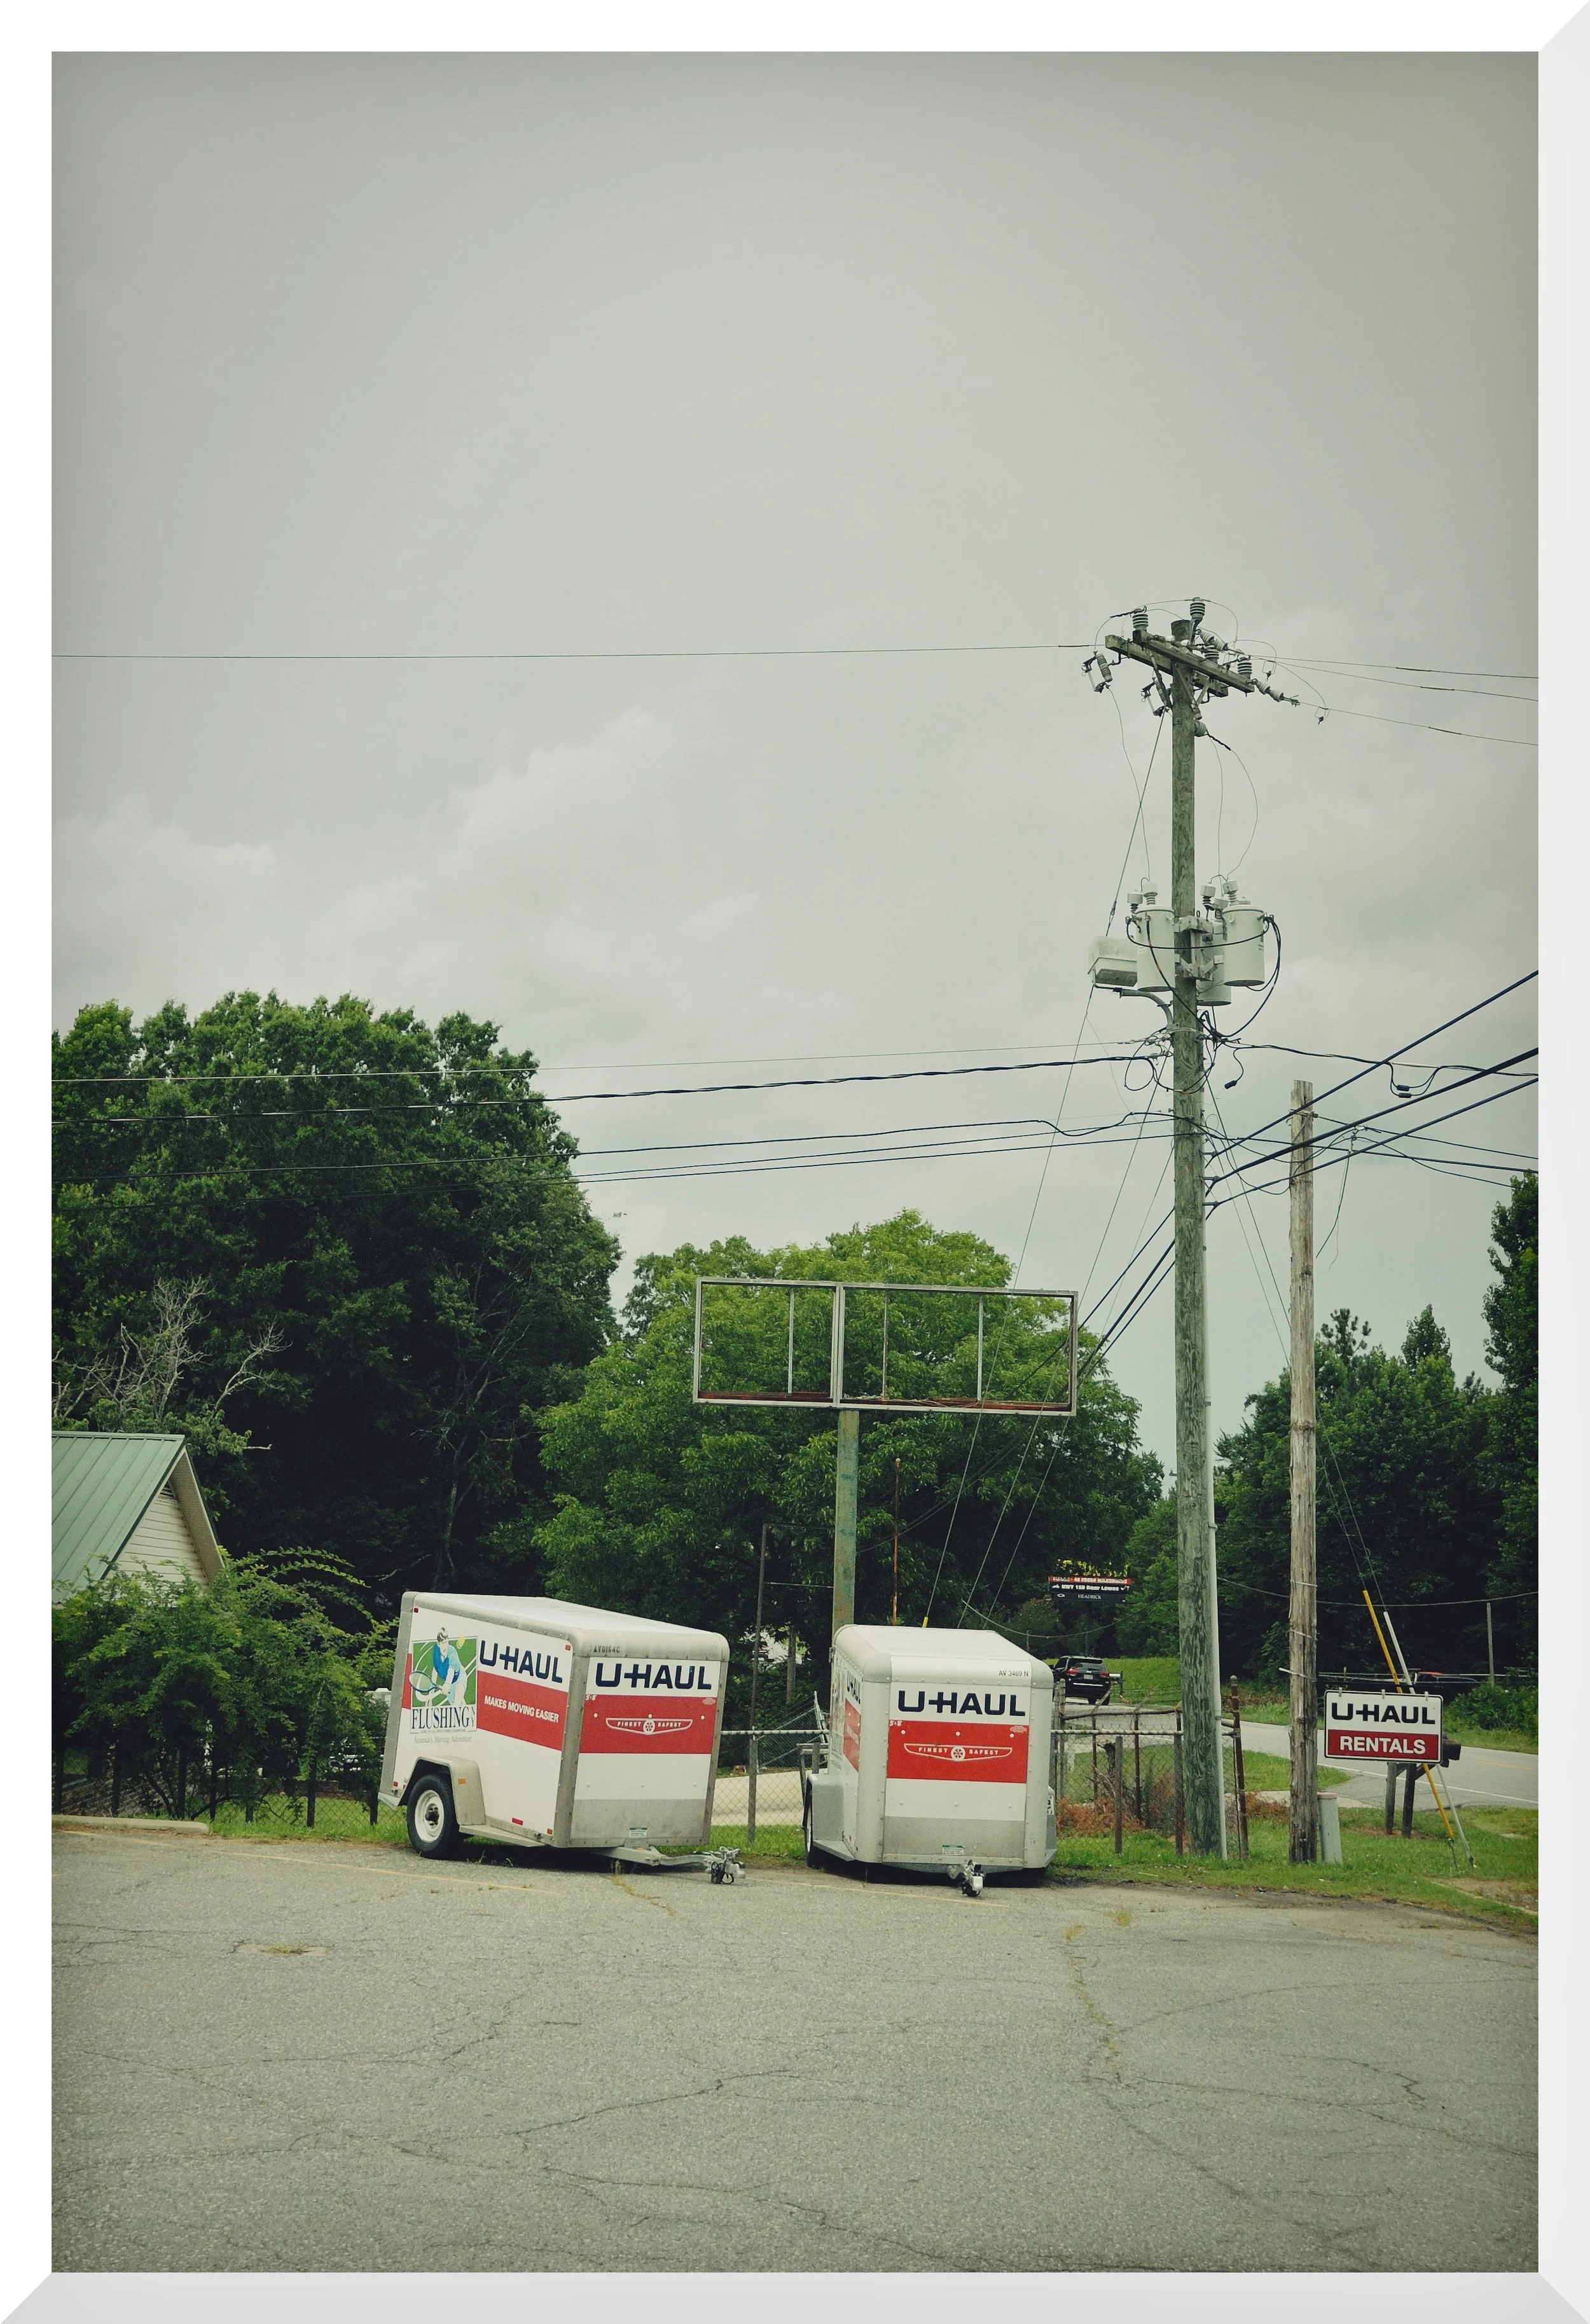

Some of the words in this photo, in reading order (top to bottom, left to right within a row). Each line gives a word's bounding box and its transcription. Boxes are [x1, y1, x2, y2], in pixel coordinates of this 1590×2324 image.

[480, 1640, 563, 1684] U-HAUL
[595, 1663, 712, 1690] U-HAUL
[484, 1695, 507, 1710] MAKES
[508, 1701, 535, 1717] MOVING
[536, 1709, 559, 1723] EASIER
[897, 1690, 1026, 1717] U-HAUL
[1331, 1702, 1435, 1725] U-HAUL
[411, 1706, 470, 1729] FLUSHING
[1339, 1735, 1426, 1755] RENTALS
